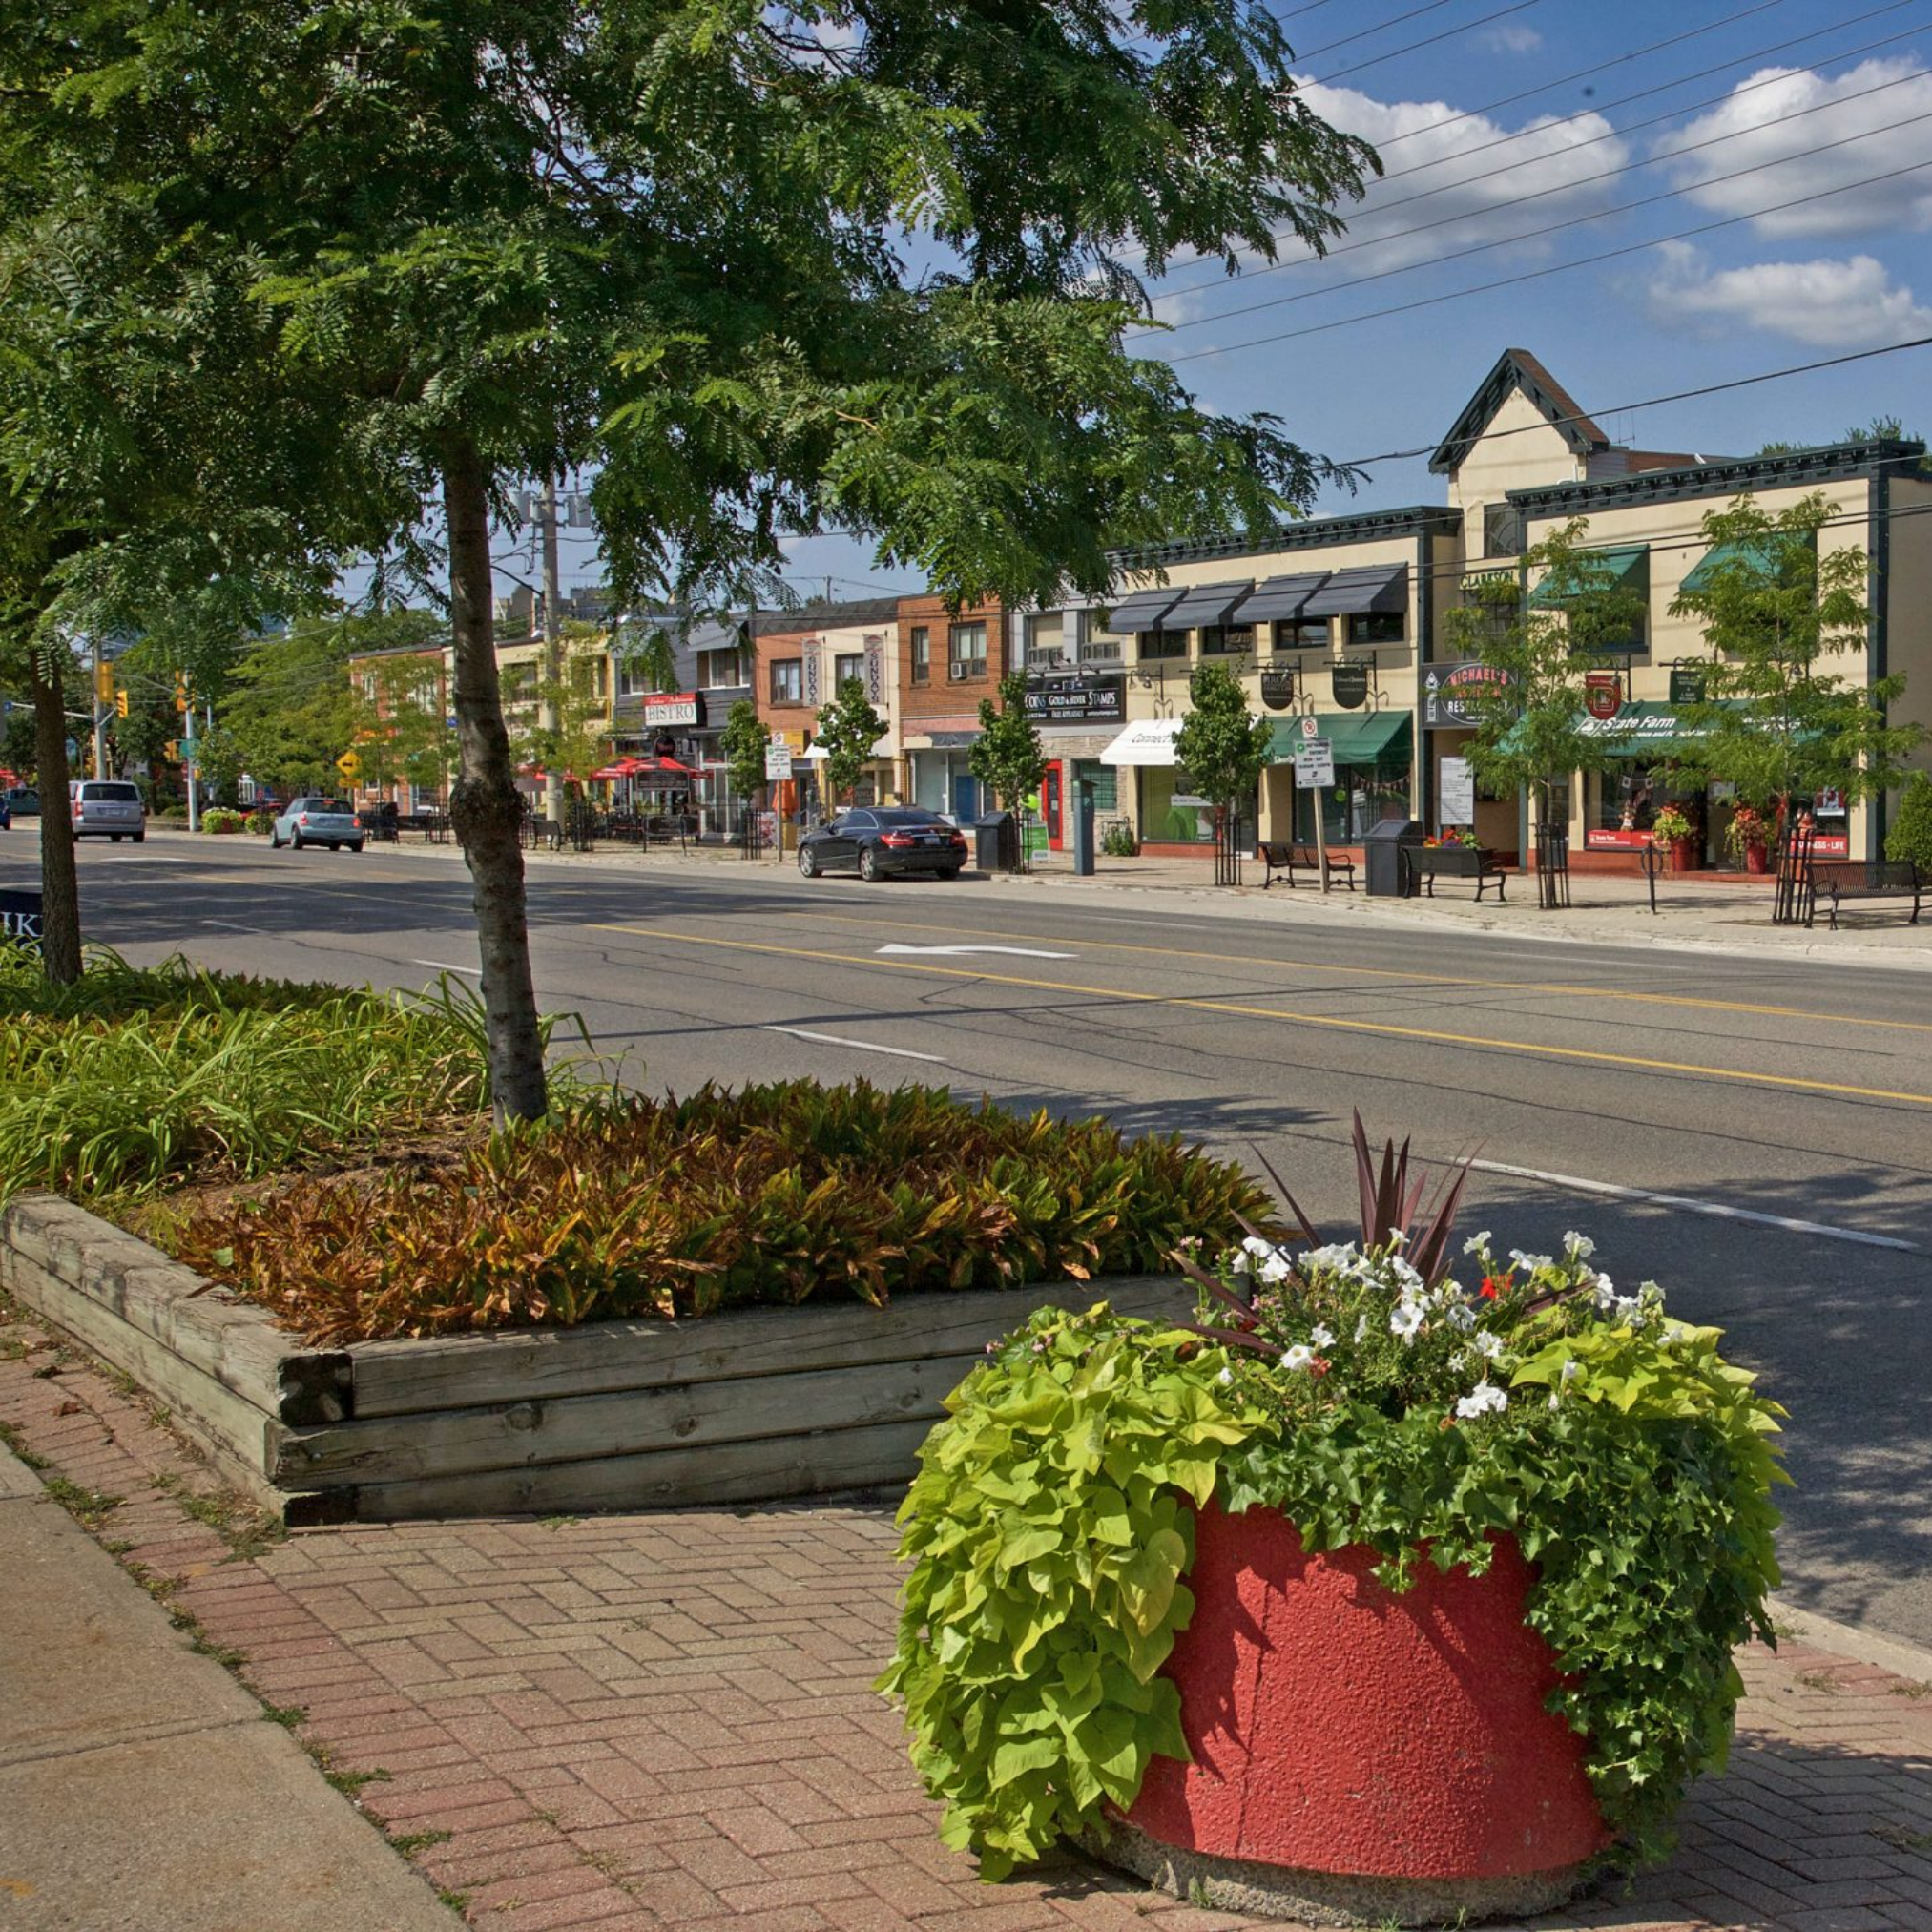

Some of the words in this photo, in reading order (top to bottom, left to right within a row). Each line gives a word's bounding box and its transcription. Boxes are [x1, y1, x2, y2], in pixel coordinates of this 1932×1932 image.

[808, 655, 818, 706] SUNDAYS
[869, 653, 880, 703] SUNDAYS
[1449, 667, 1507, 686] MICHAEL'S
[1049, 695, 1065, 706] GOLD
[1088, 690, 1116, 706] STAMPS
[648, 704, 695, 721] BISTRO
[1603, 717, 1639, 730] State
[1639, 715, 1677, 729] Farm
[1831, 841, 1844, 850] LIFE
